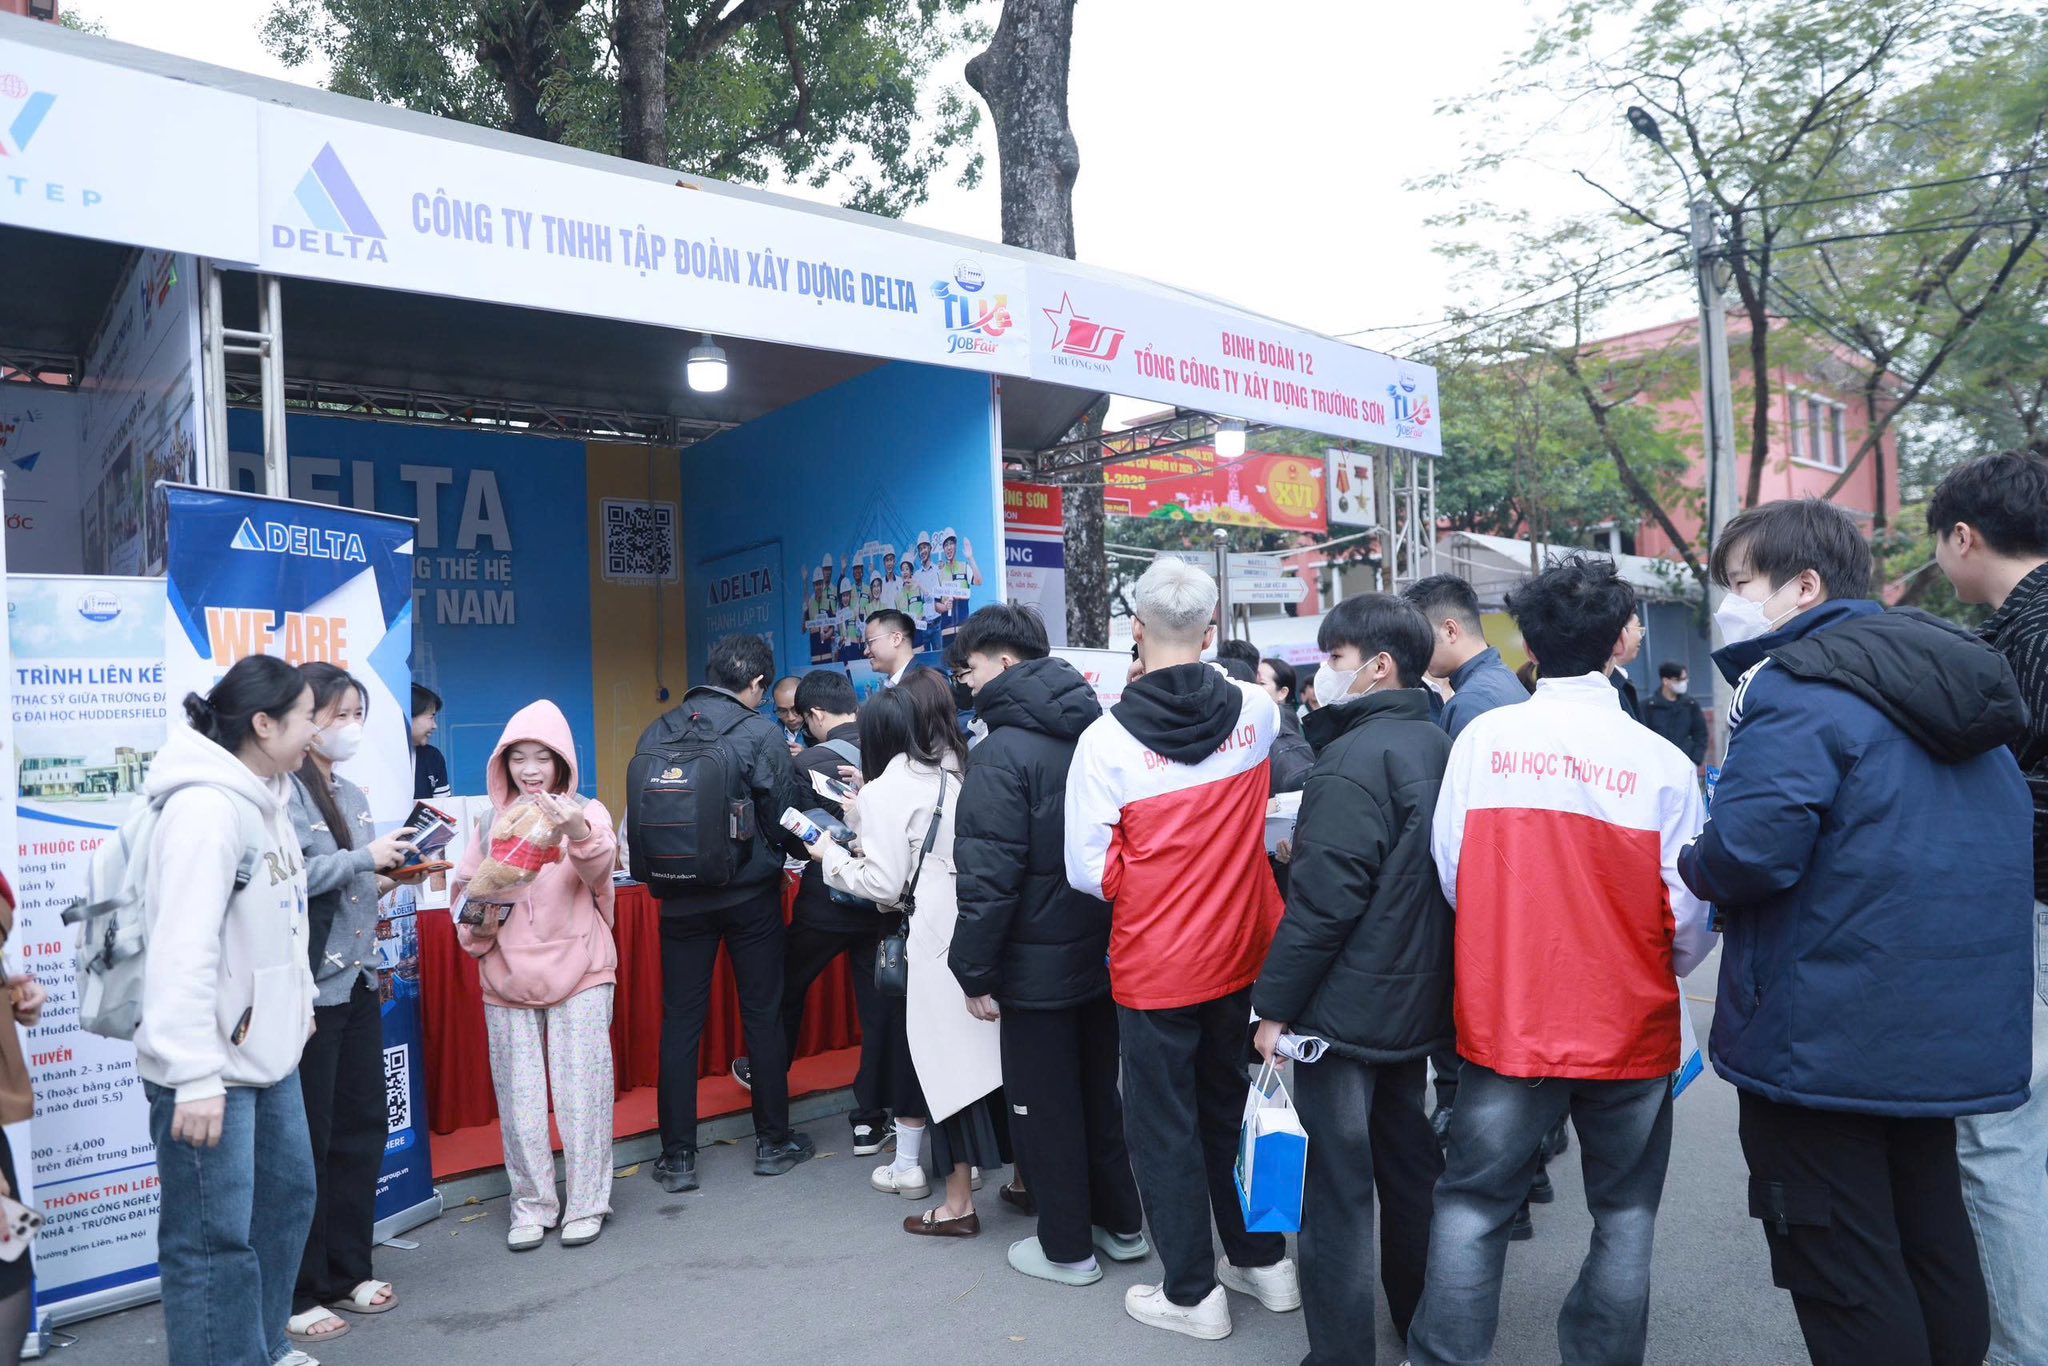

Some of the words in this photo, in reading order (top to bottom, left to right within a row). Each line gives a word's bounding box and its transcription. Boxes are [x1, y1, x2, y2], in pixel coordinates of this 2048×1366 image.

[272, 224, 388, 263] DELTA
[412, 187, 493, 244] CÔNG
[501, 207, 533, 250] TY
[541, 214, 612, 264] TNHH
[619, 224, 666, 277] TẬP
[674, 237, 740, 284] ĐOÀN
[746, 247, 789, 292] XÂY
[797, 260, 855, 305] DỰNG
[860, 272, 918, 314] DELTA
[1221, 332, 1255, 361] BINH
[1259, 340, 1294, 371] ĐOÀN
[1298, 352, 1313, 375] 12
[1134, 342, 1175, 381] TỔNG
[1180, 356, 1219, 391] CÔNG
[1223, 369, 1239, 394] TY
[1244, 371, 1269, 401] XÂY
[1274, 380, 1308, 411] DỰNG
[1311, 388, 1358, 420] TRƯỜNG
[1362, 400, 1385, 425] SƠN
[1026, 492, 1048, 509] SƠN
[1275, 481, 1314, 508] XVI
[5, 514, 33, 529] ỚC
[265, 521, 366, 563] DELTA
[437, 552, 478, 580] THẾ
[485, 555, 512, 586] HỆ
[721, 567, 772, 603] DELTA
[436, 589, 515, 624] NAM
[208, 609, 274, 667] WE
[285, 613, 348, 670] ARE
[16, 664, 82, 685] TRÌNH
[89, 664, 132, 684] LIÊN
[139, 662, 166, 683] KẾ
[15, 694, 48, 707] THẠC
[51, 692, 66, 704] SỸ
[69, 692, 98, 704] GIỮA
[101, 691, 150, 704] TRƯỜNG
[24, 711, 46, 724] ĐẠI
[50, 710, 76, 723] HỌC
[79, 708, 167, 721] HUDDERSFIELD
[1236, 723, 1257, 749] LỢI
[1491, 751, 1517, 778] ĐẠI
[1521, 751, 1558, 780] HỌC
[1563, 755, 1605, 785] THỦY
[1605, 767, 1639, 798] LỢI
[33, 839, 75, 856] THUỘC
[51, 861, 66, 870] tin
[37, 941, 61, 957] TẠO
[37, 962, 65, 973] hoặc
[46, 994, 66, 1003] oặc
[31, 1045, 72, 1066] TUYỂN
[43, 1068, 76, 1081] thành
[96, 1063, 102, 1073] 3
[107, 1060, 131, 1070] năm
[47, 1087, 79, 1101] (hoặc
[83, 1081, 110, 1093] bằng
[114, 1075, 133, 1087] cấp
[47, 1102, 69, 1114] nào
[37, 1161, 60, 1174] trên
[65, 1153, 93, 1167] điểm
[97, 1148, 127, 1161] trung
[43, 1188, 100, 1210] THÔNG
[103, 1183, 128, 1196] TIN
[57, 1208, 88, 1223] DỤNG
[91, 1201, 120, 1215] CÔNG
[123, 1194, 151, 1207] NGHỆ
[41, 1227, 65, 1240] NHÀ
[68, 1225, 74, 1233] 4
[82, 1213, 126, 1230] TRƯỜNG
[128, 1208, 147, 1220] ĐẠI
[70, 1244, 89, 1254] Kim
[130, 1230, 147, 1241] Nội
